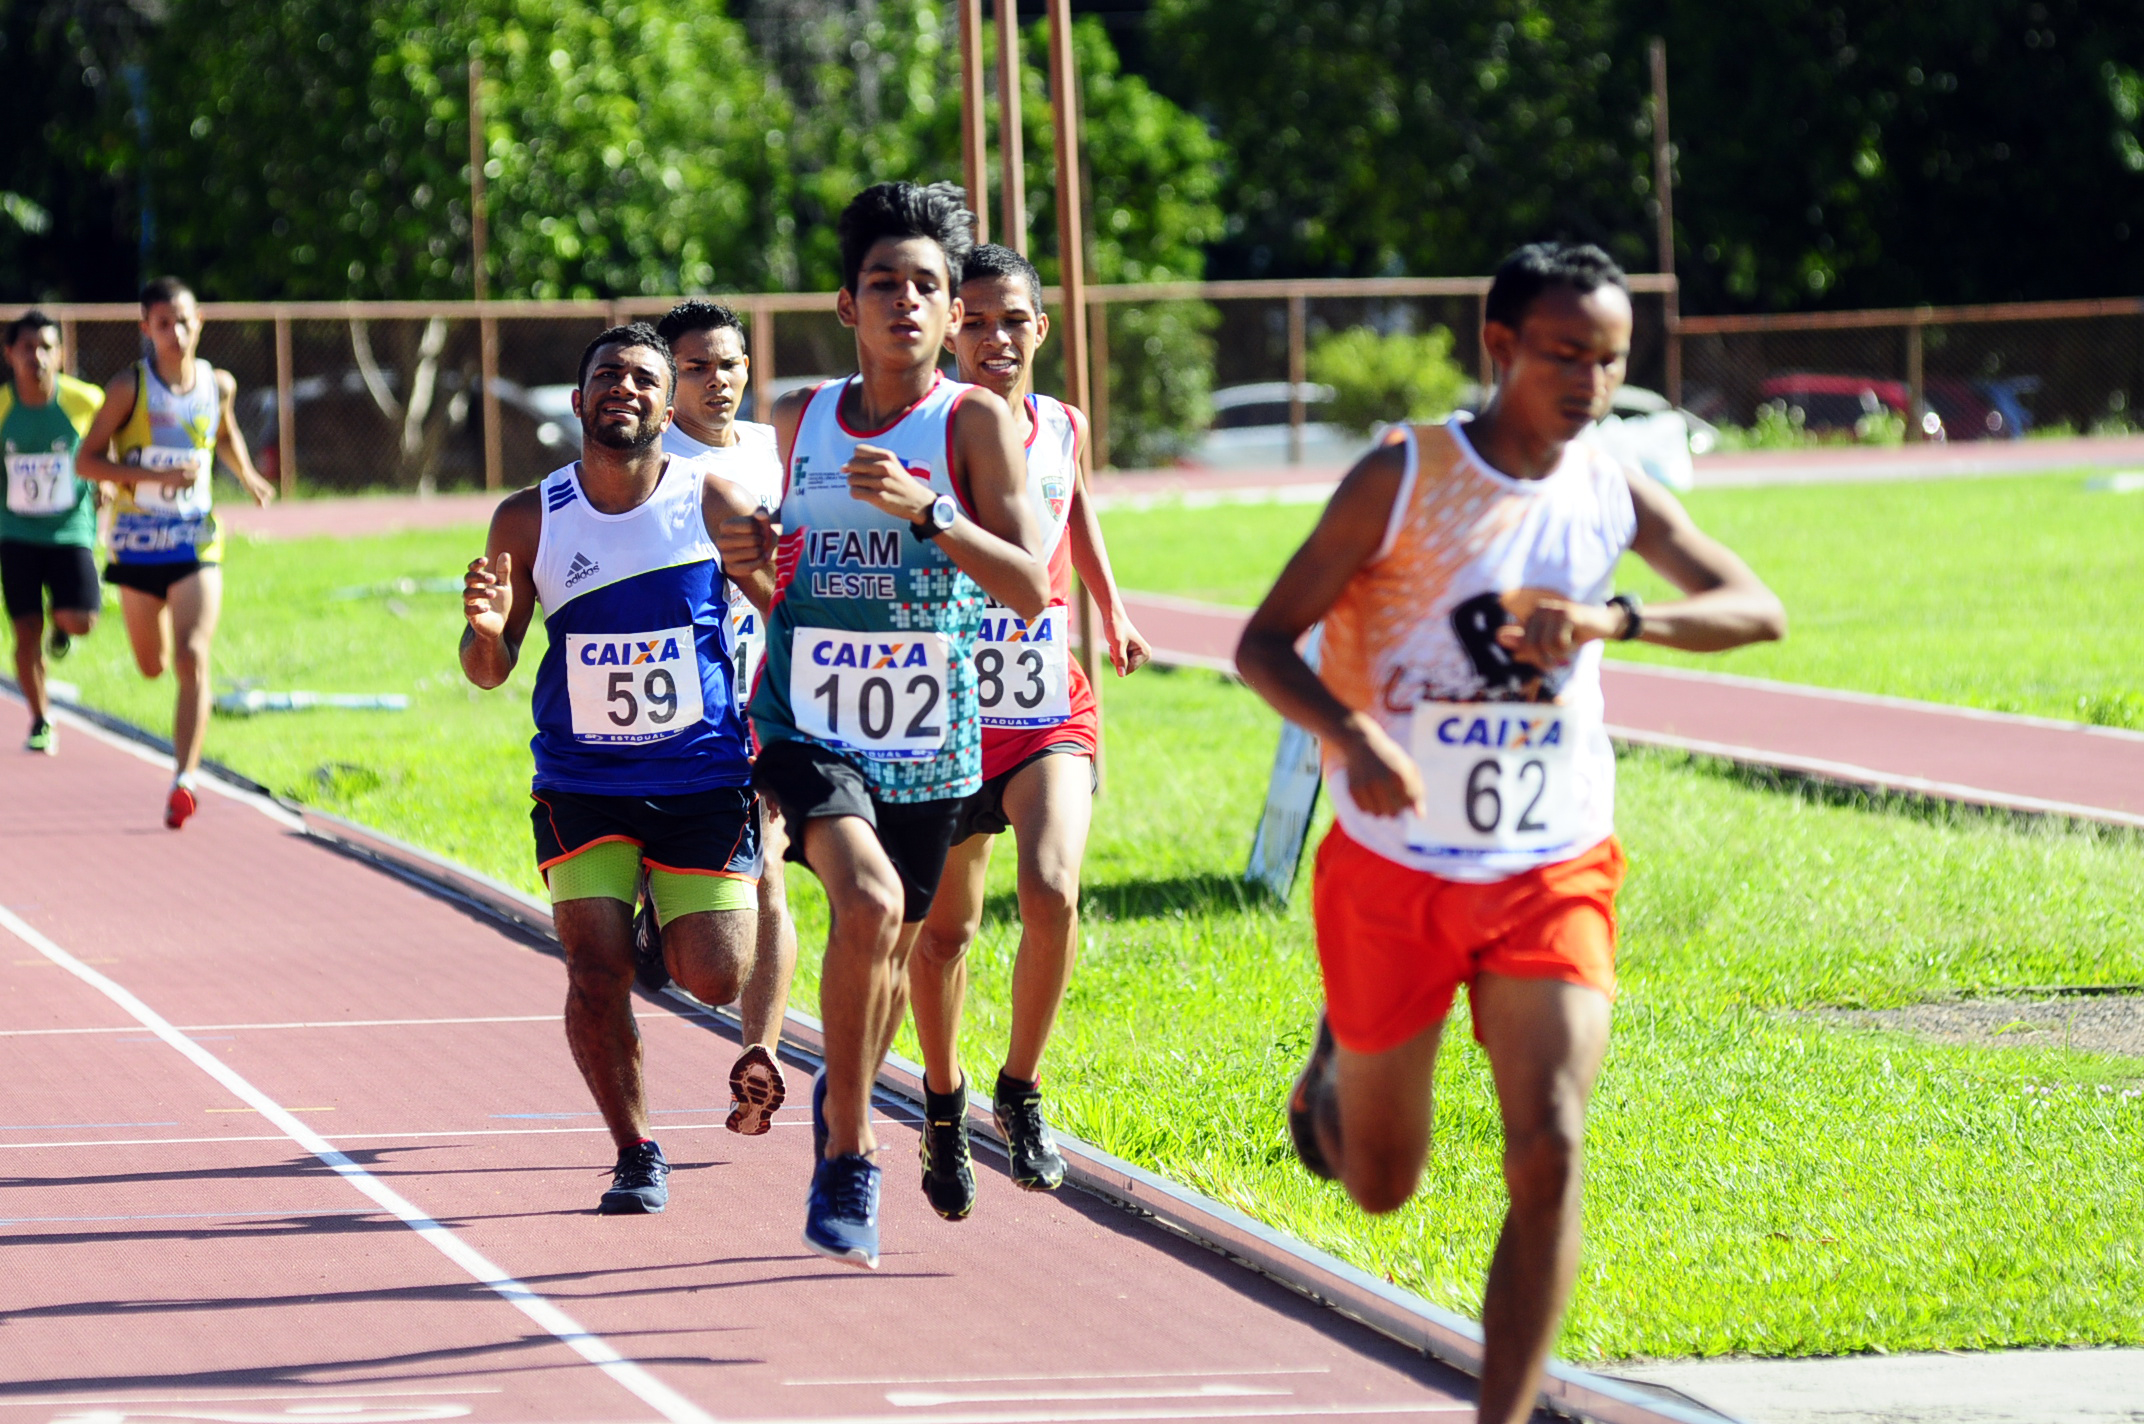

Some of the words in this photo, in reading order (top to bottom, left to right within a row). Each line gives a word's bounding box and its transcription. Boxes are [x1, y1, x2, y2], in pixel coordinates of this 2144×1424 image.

[808, 530, 901, 567] IFAM
[565, 564, 600, 588] adidas
[812, 572, 896, 599] LESTE
[978, 617, 1053, 642] AIXA
[580, 637, 680, 666] CAIXA
[811, 640, 927, 669] CAIXA
[974, 648, 1045, 709] 83
[606, 668, 678, 727] 59
[814, 673, 941, 740] 102
[610, 732, 665, 742] ESTADUAL
[1437, 717, 1561, 749] CAIXA
[1466, 758, 1547, 833] 62
